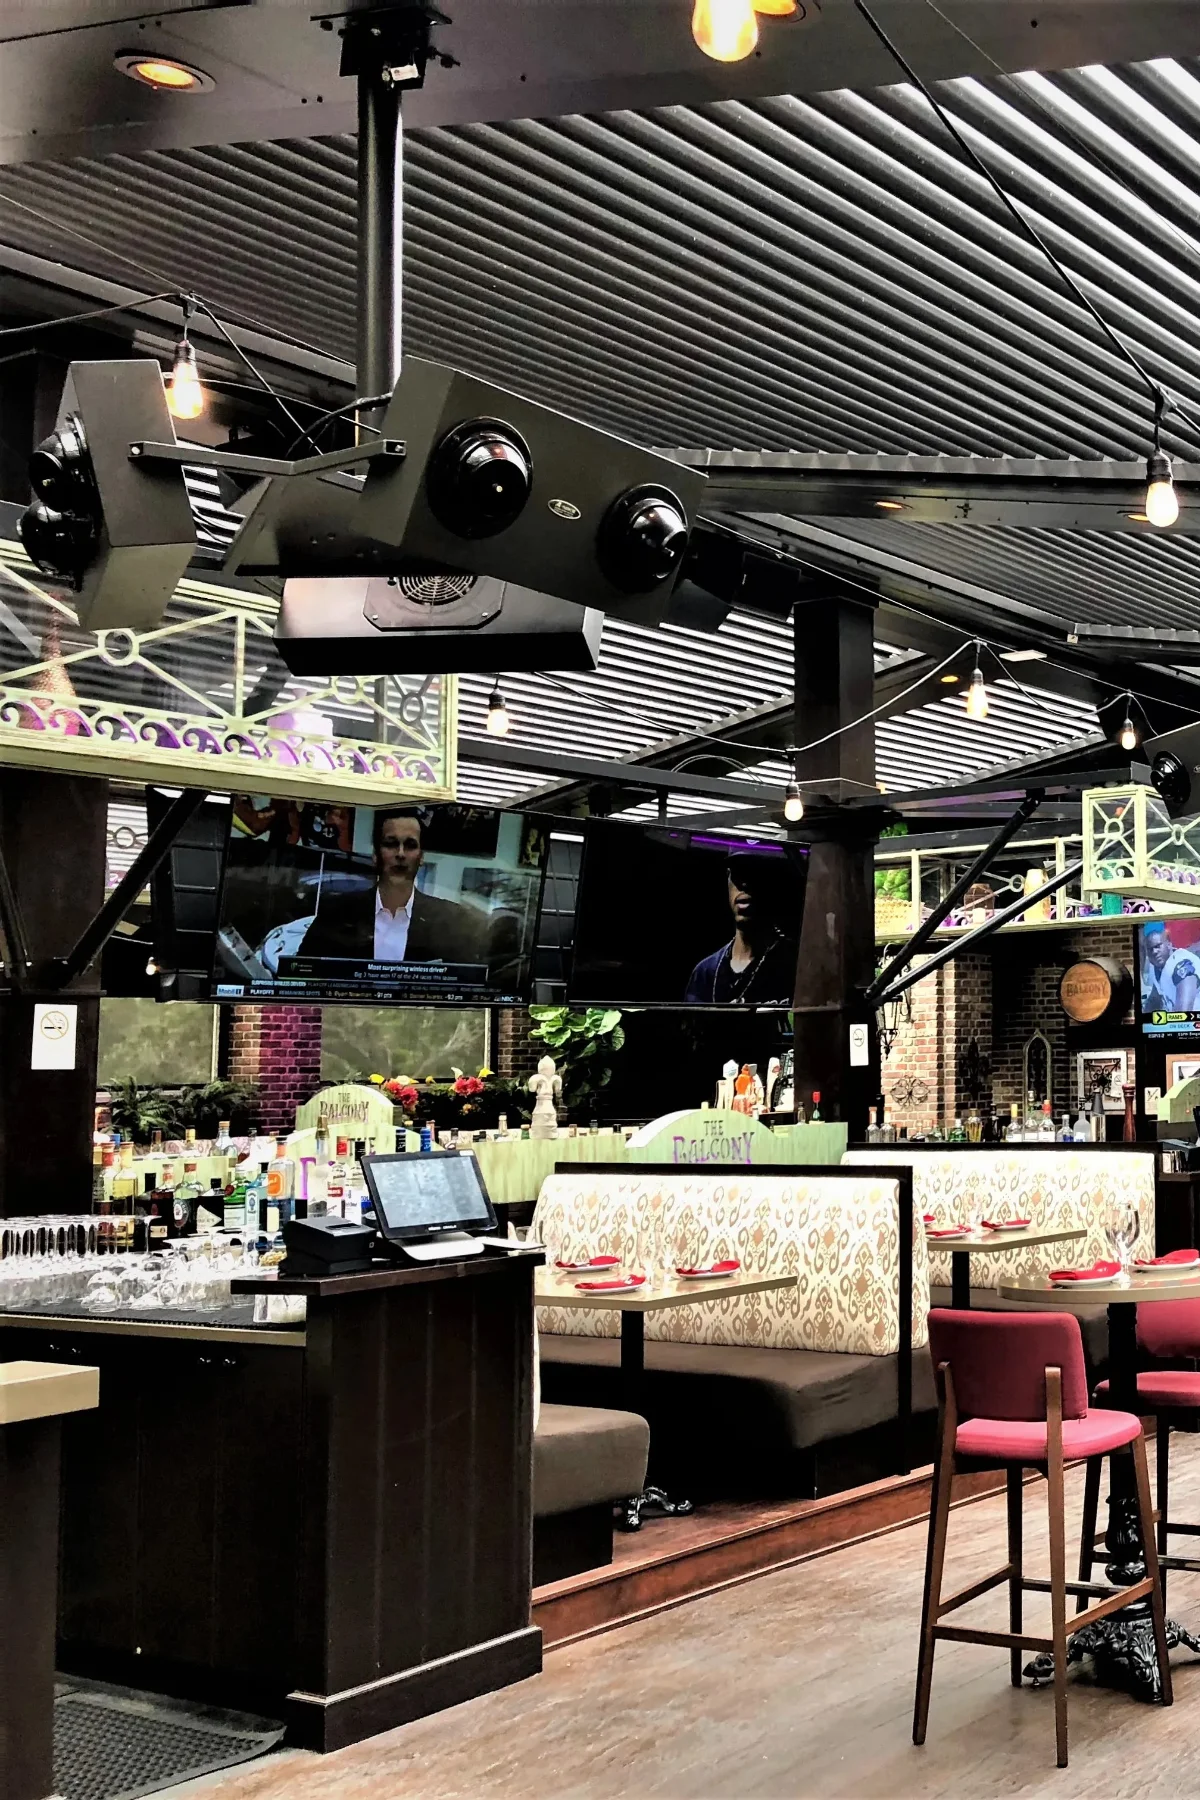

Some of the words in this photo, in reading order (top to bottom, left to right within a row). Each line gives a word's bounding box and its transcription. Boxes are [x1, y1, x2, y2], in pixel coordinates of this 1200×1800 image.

[382, 964, 409, 973] surprising
[1066, 981, 1106, 997] BALCONY
[338, 1092, 351, 1103] THE
[320, 1101, 369, 1122] BALCONY
[703, 1120, 724, 1136] THE
[673, 1132, 755, 1164] BALCONY
